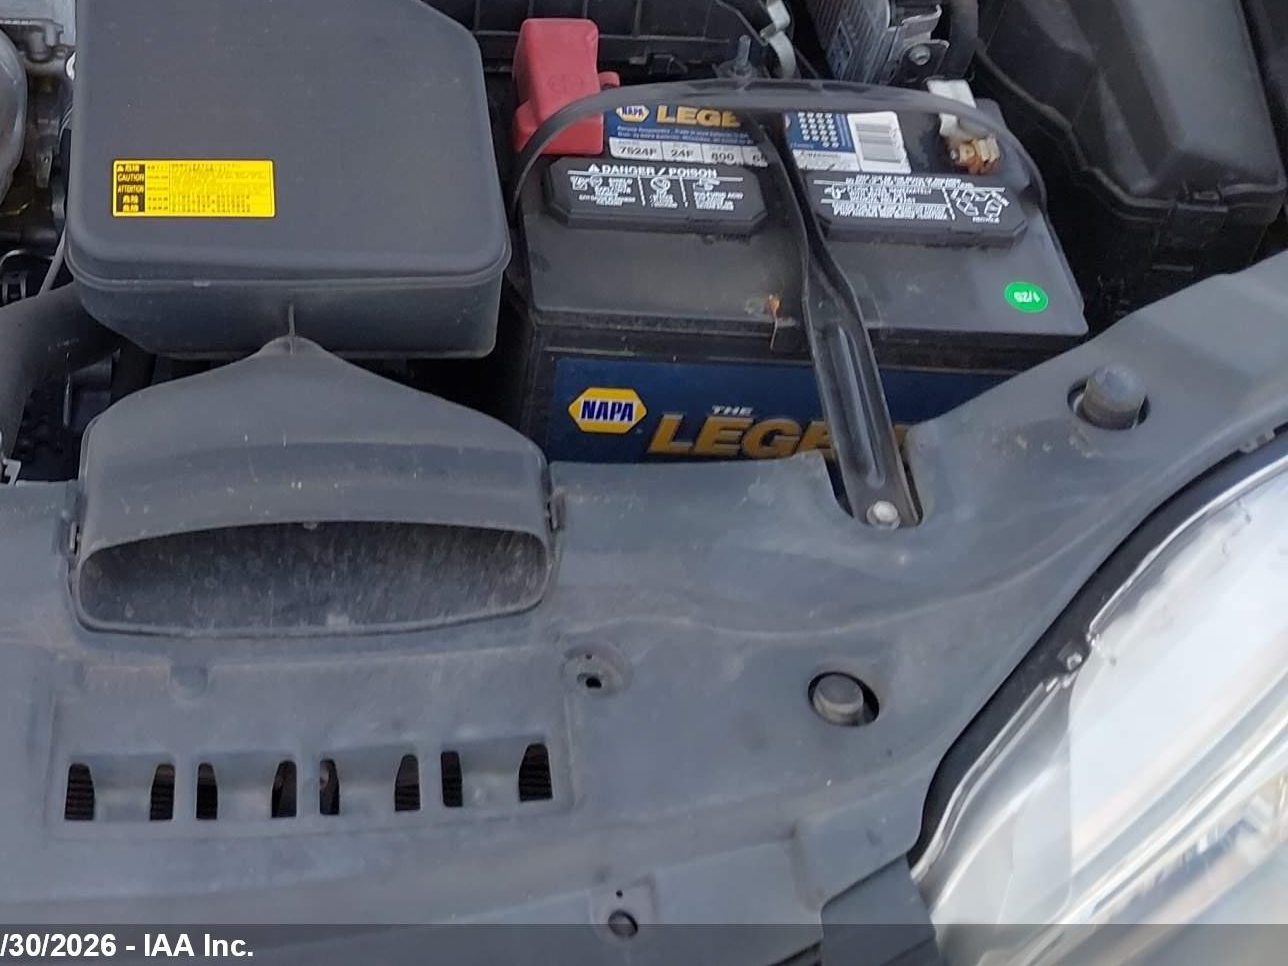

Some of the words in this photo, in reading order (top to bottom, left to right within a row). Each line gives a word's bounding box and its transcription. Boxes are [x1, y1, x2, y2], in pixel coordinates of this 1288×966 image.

[602, 164, 655, 176] DANGER
[668, 168, 718, 178] POISON
[117, 173, 144, 183] CAUTION
[580, 399, 634, 422] NAPA
[711, 404, 754, 416] THE
